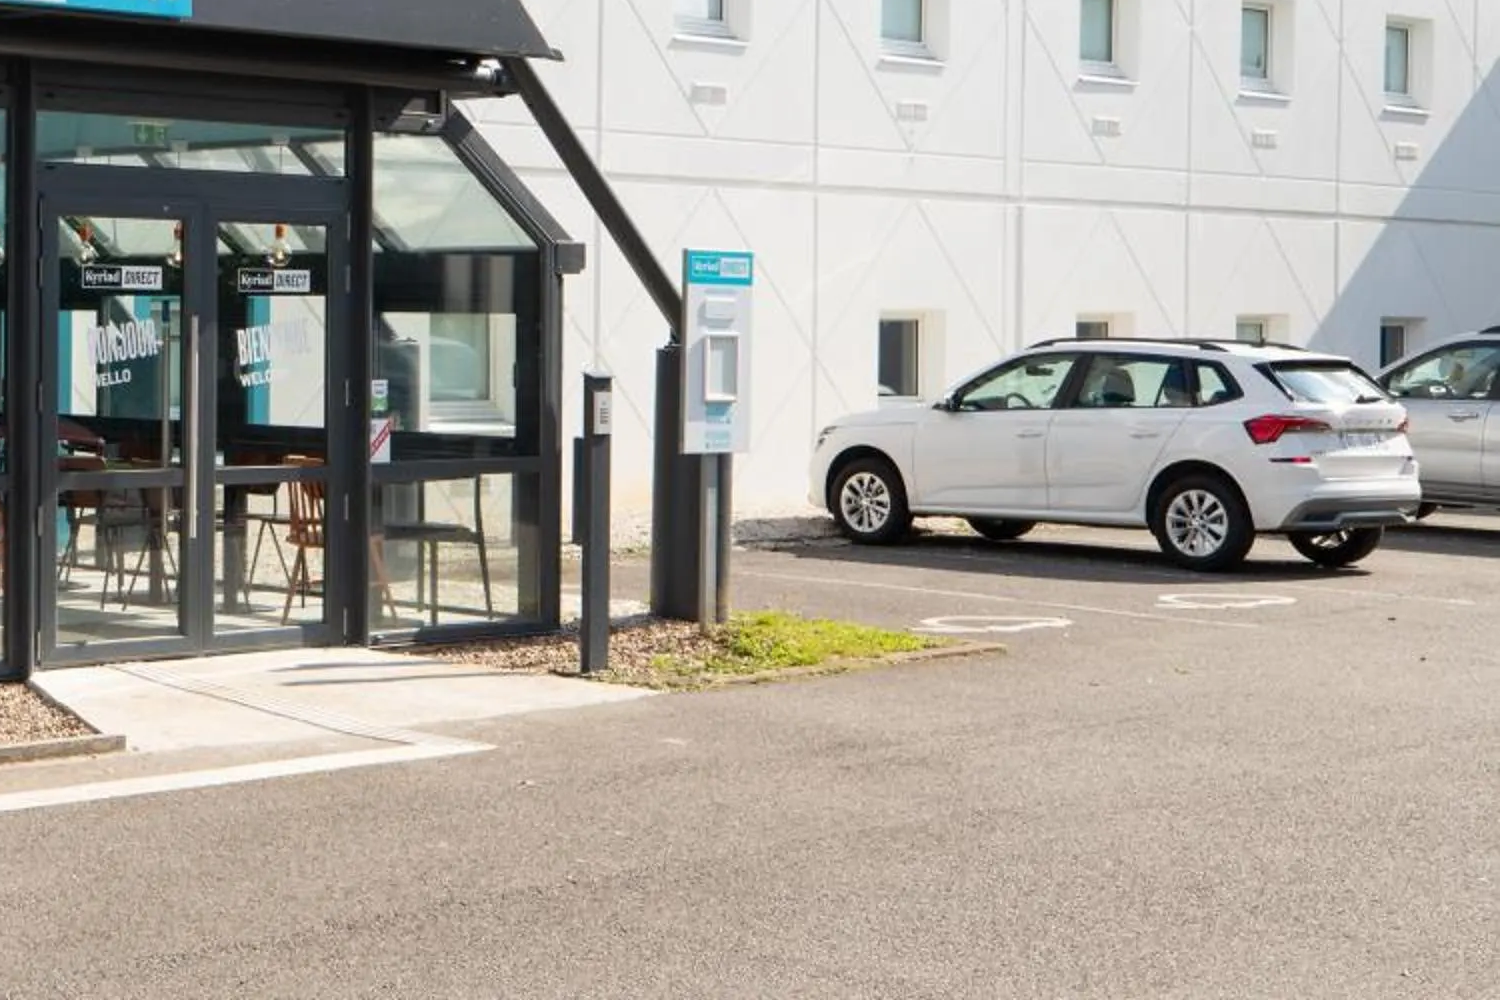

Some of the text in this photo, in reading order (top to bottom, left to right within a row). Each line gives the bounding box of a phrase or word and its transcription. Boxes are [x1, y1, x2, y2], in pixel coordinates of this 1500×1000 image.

[84, 269, 160, 285] Kyriad DIRECT
[87, 318, 160, 365] ONJOUR
